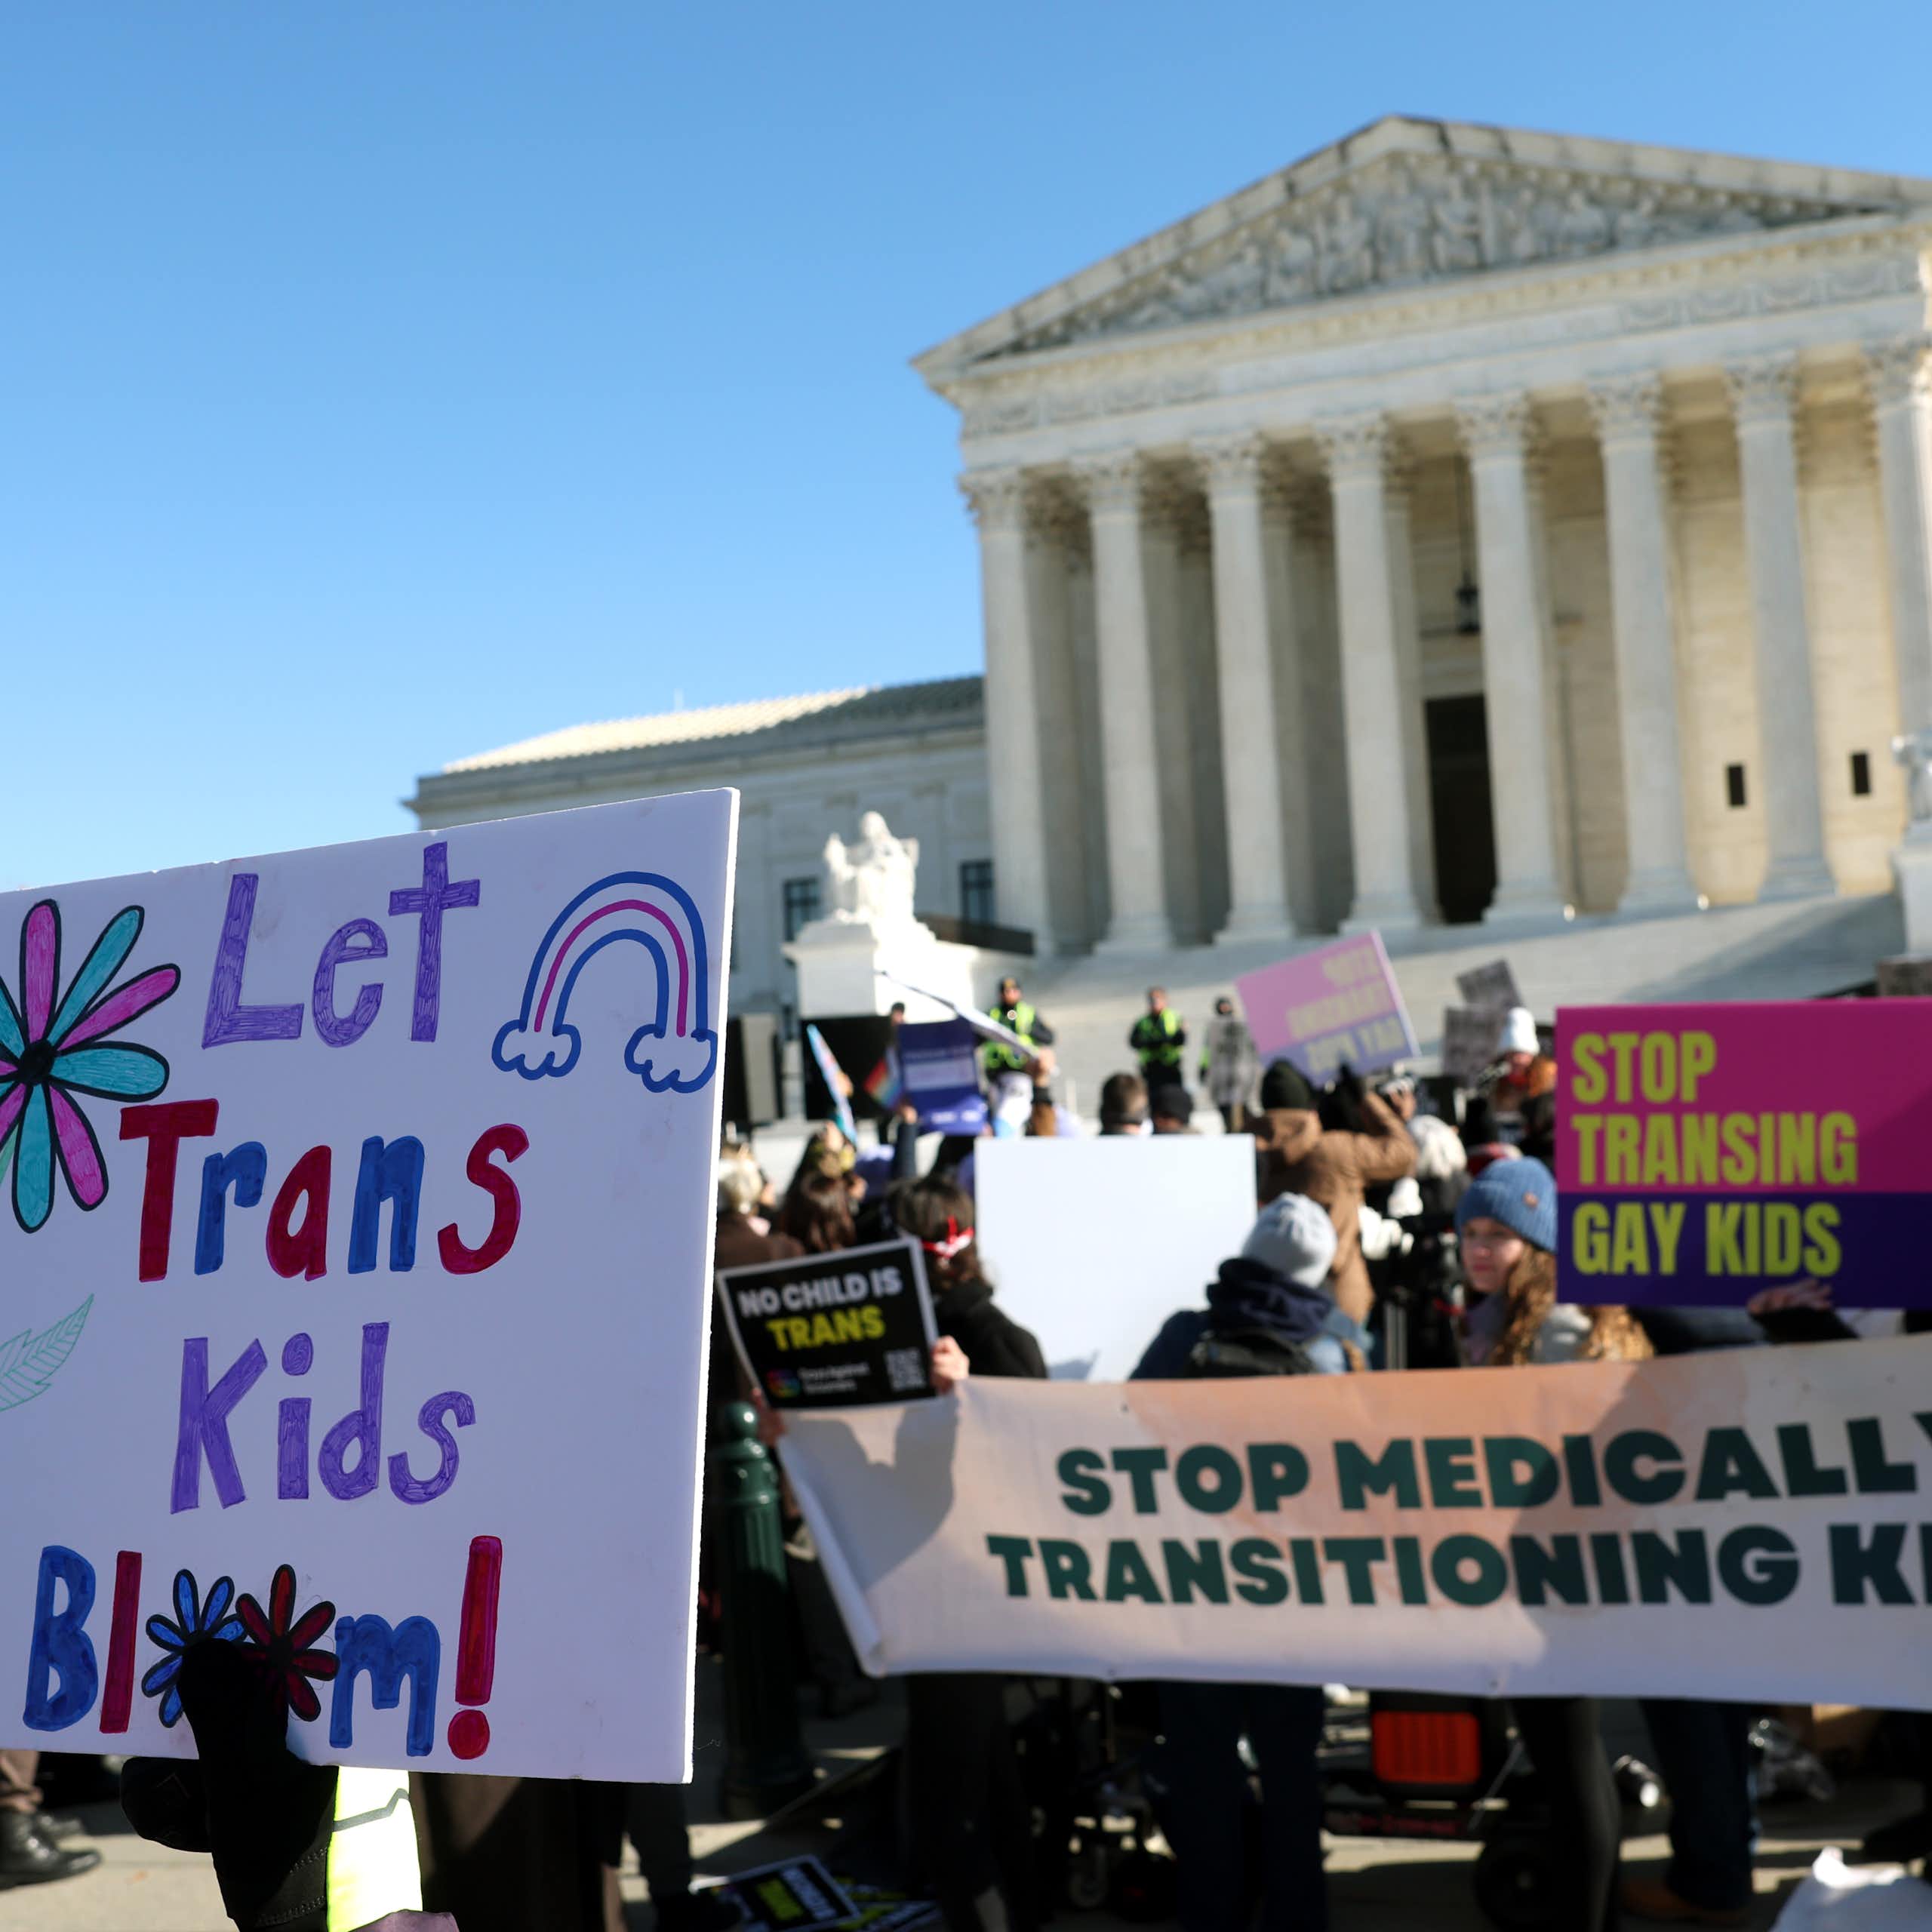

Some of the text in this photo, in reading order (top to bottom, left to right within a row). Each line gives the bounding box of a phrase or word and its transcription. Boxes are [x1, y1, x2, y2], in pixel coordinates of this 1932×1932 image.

[202, 841, 481, 1049] Let
[1571, 1031, 1717, 1104] STOP
[1571, 1112, 1859, 1186] TRANSING
[119, 1098, 530, 1281] Trans
[1573, 1201, 1841, 1278] GAY KIDS
[737, 1266, 903, 1317] NO CHILD IS
[766, 1305, 885, 1352] TRANS
[171, 1321, 475, 1514] Kids
[1057, 1442, 1310, 1517] STOP
[985, 1523, 1801, 1607] TRANSITIONING
